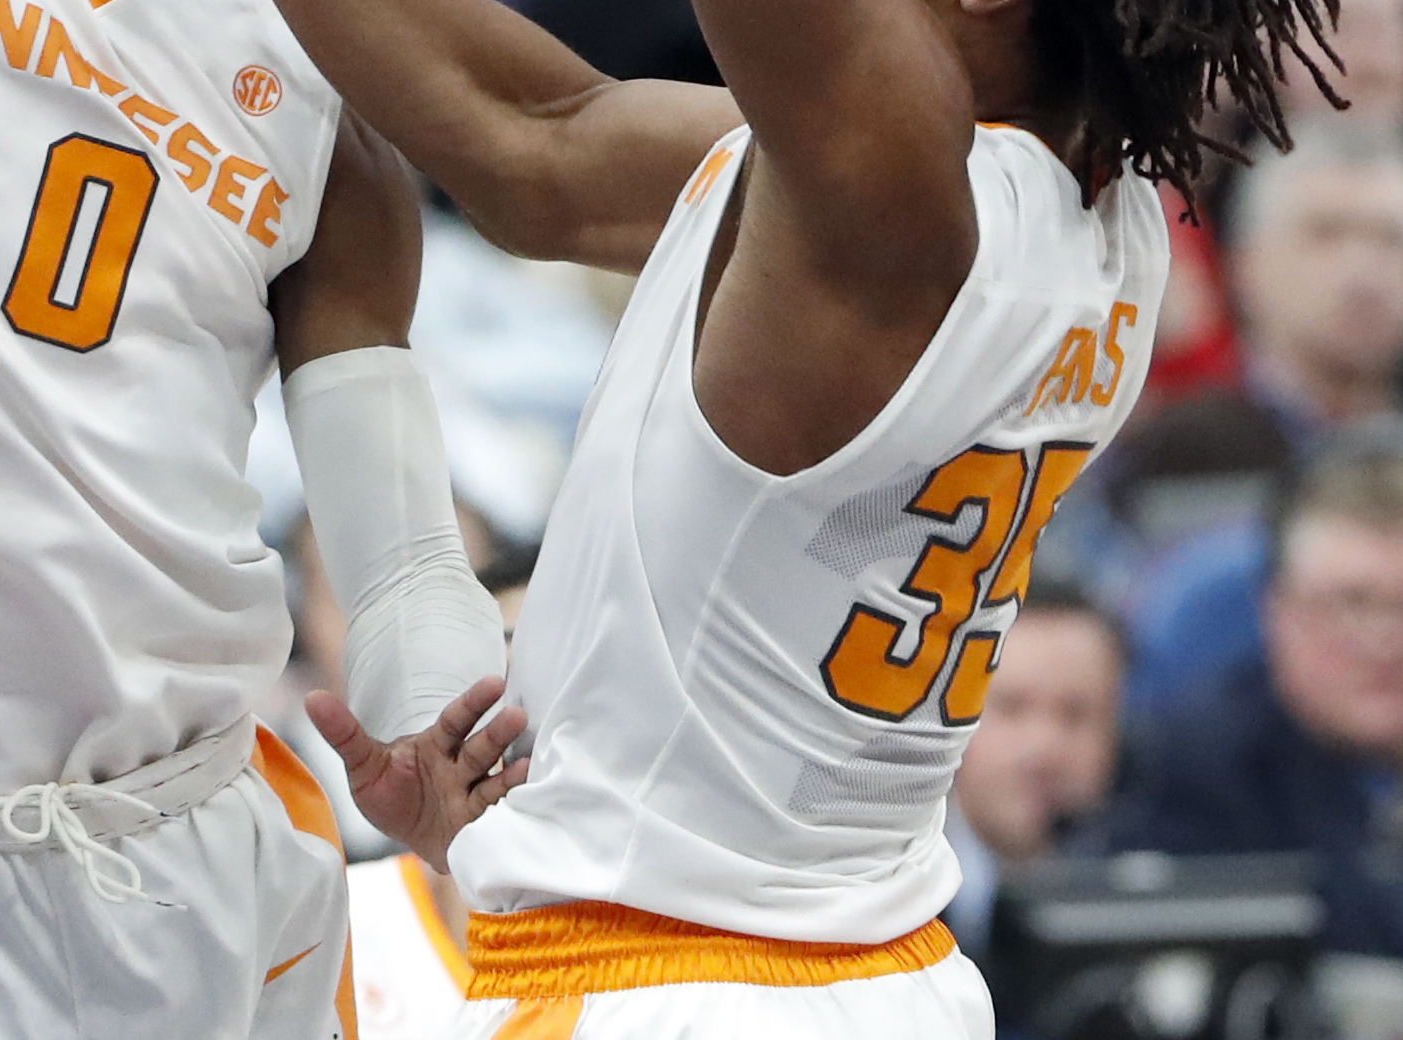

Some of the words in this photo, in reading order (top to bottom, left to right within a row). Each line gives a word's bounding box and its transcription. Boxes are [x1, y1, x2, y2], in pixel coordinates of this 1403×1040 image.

[236, 67, 279, 113] SEC
[1, 131, 160, 353] 0
[819, 441, 1098, 727] 35
